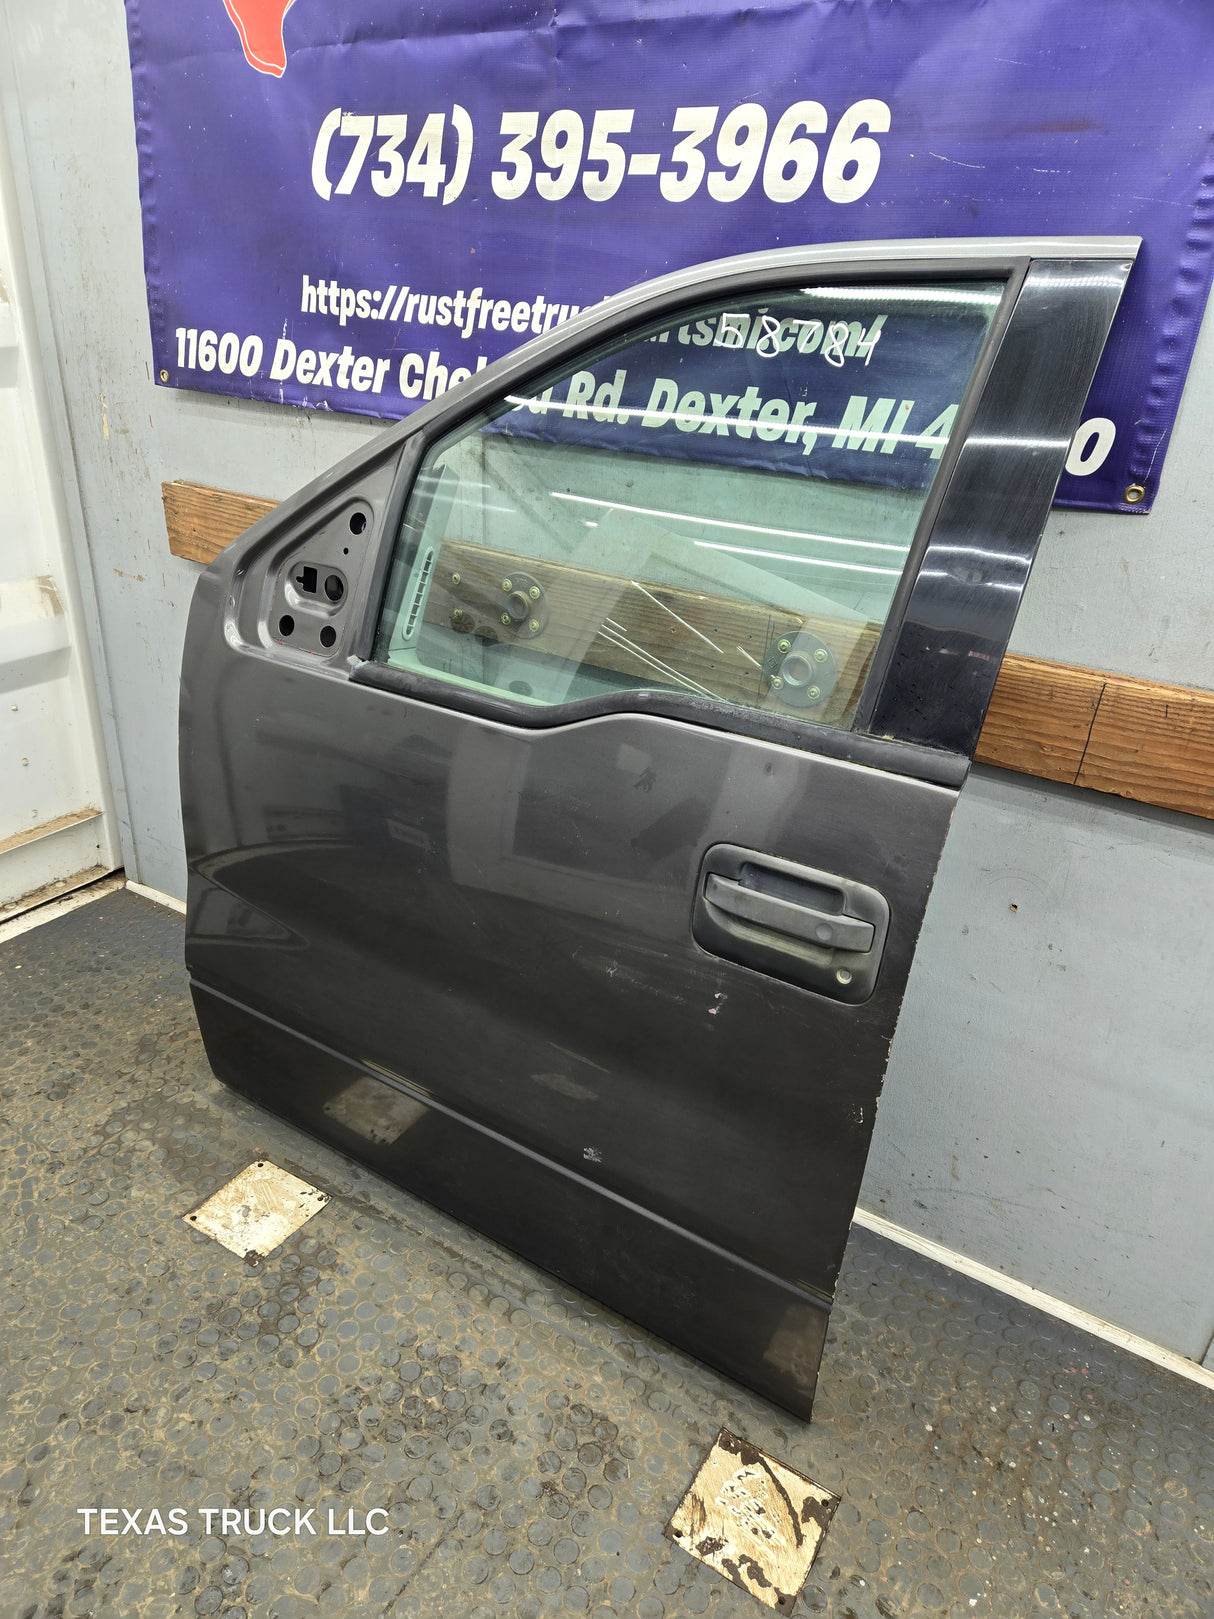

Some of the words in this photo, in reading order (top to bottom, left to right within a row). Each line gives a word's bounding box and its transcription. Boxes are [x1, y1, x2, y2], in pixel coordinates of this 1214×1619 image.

[311, 104, 474, 206] (734)
[491, 99, 892, 204] 395-3966
[175, 327, 264, 378] 11600
[269, 338, 391, 394] Dexter
[562, 369, 630, 424] Rd.
[641, 377, 818, 456] Dexter,
[831, 395, 915, 454] MI
[714, 312, 882, 367] 58784
